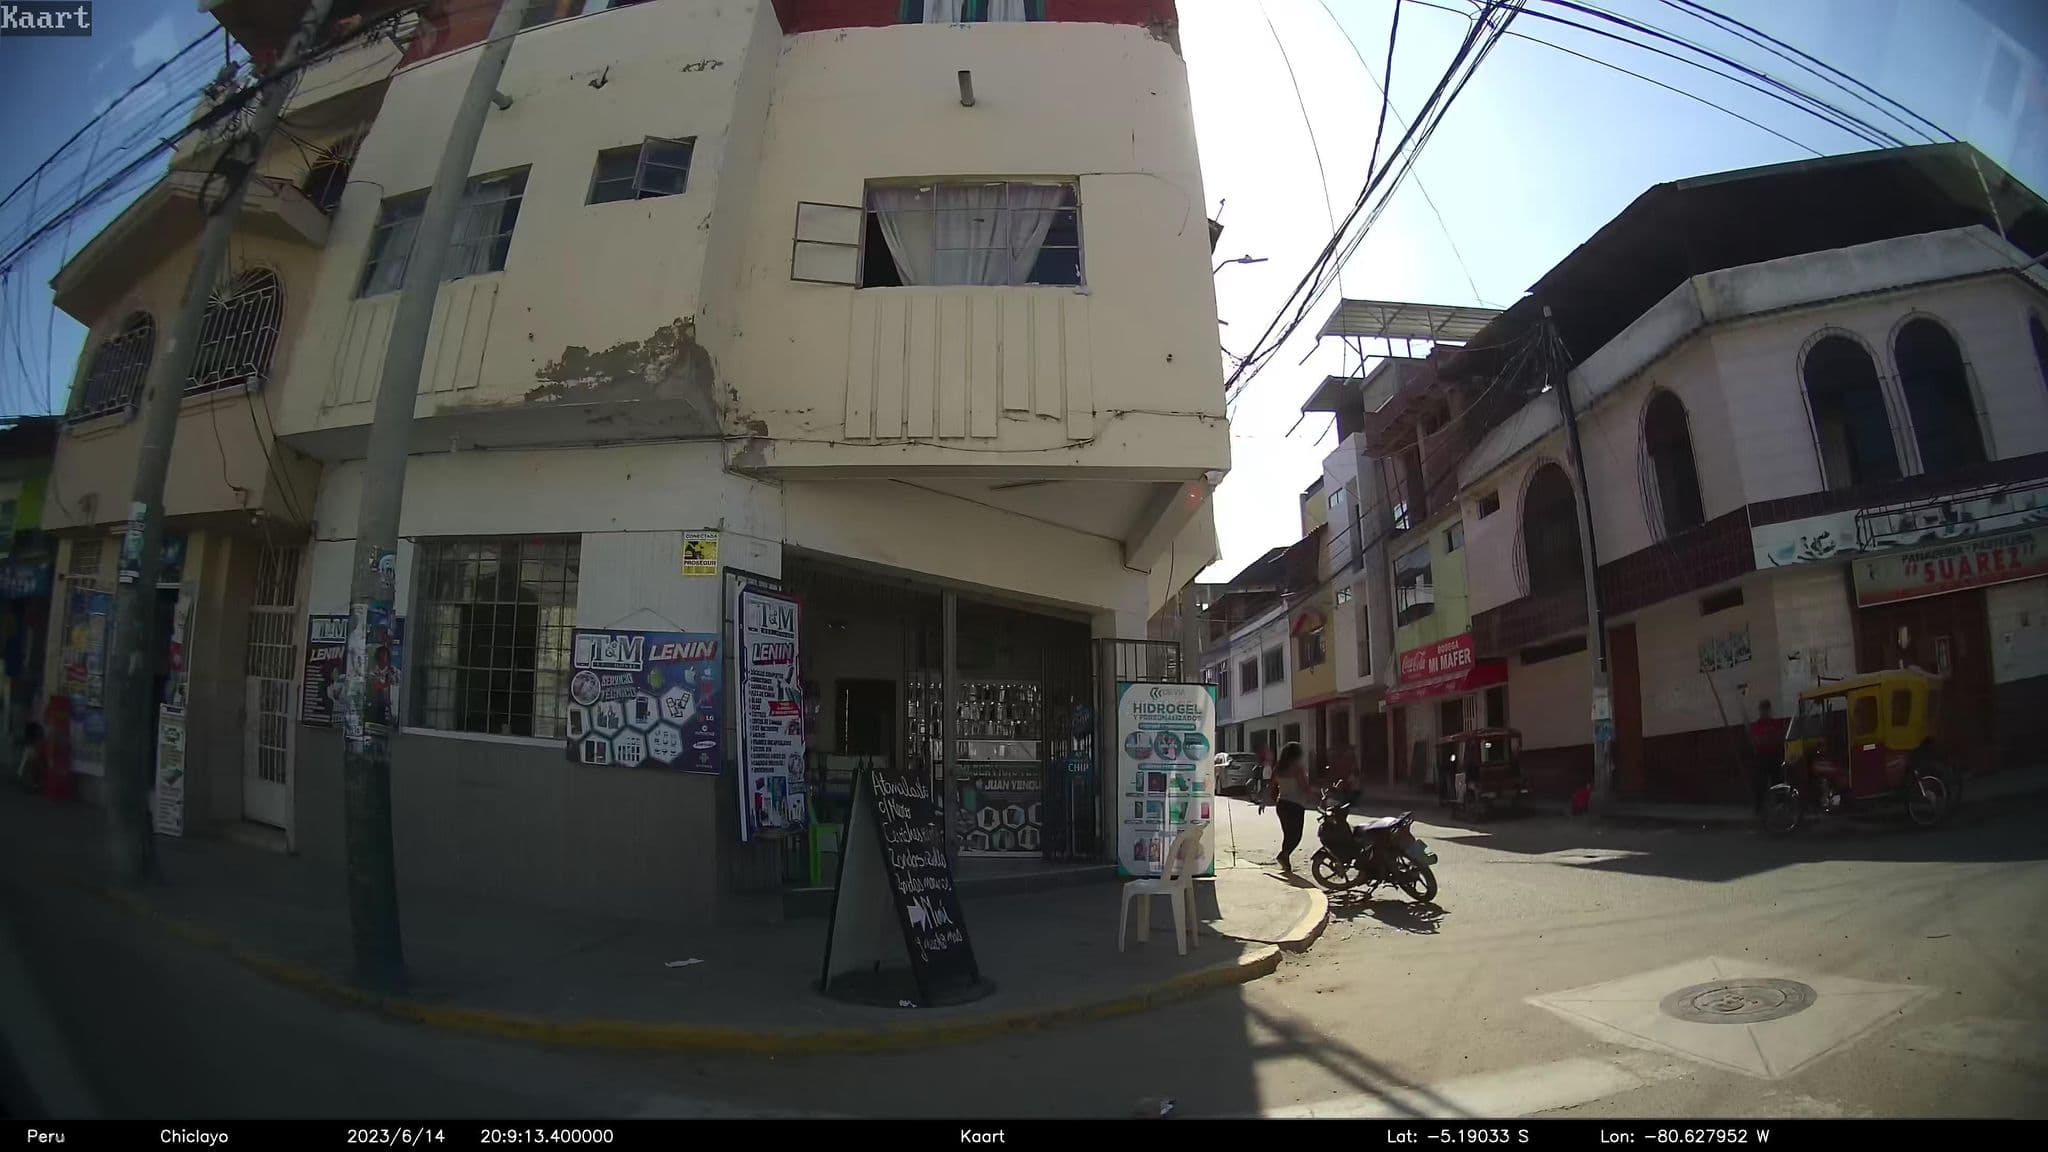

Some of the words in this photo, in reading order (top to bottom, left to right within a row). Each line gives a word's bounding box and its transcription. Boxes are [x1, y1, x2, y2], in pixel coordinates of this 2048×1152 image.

[310, 646, 346, 662] LENIN
[648, 640, 717, 662] LENIN
[752, 642, 794, 664] LENIN
[1428, 657, 1439, 672] MI
[1440, 648, 1471, 670] MAFER
[1133, 703, 1202, 714] HIDROGEL
[1067, 762, 1089, 773] CHIP
